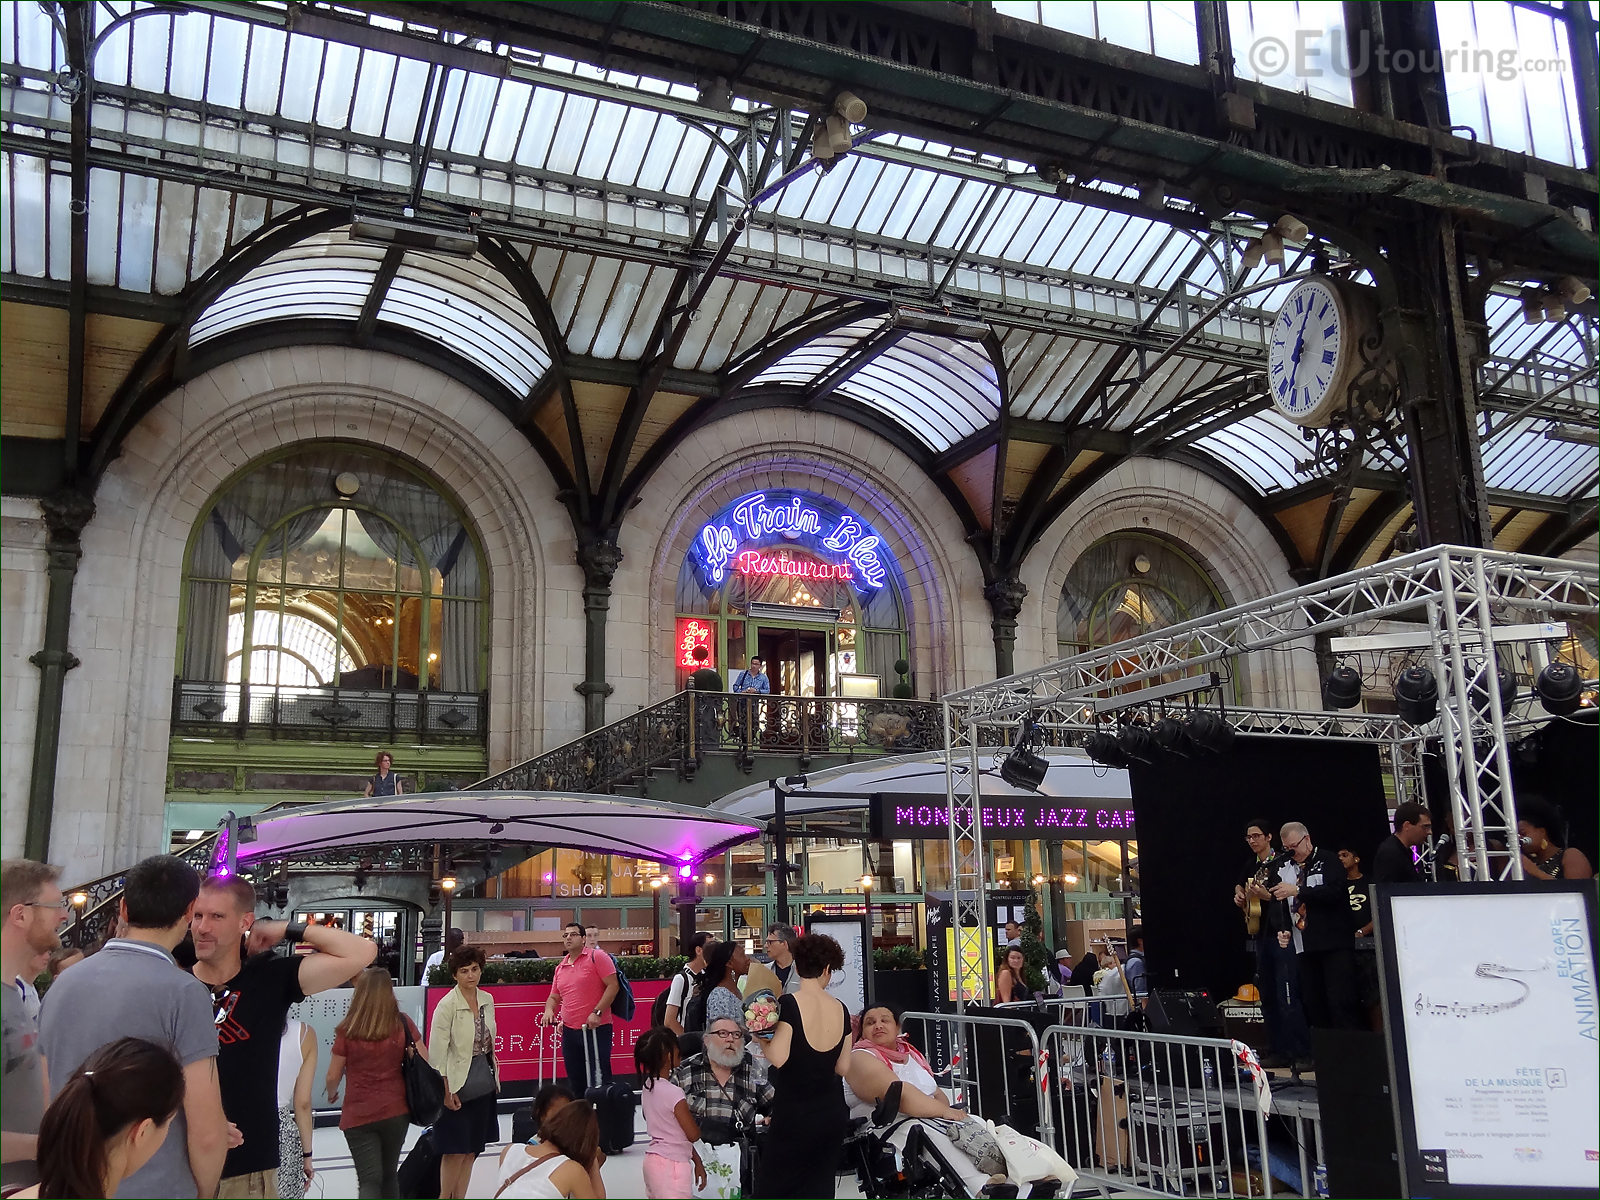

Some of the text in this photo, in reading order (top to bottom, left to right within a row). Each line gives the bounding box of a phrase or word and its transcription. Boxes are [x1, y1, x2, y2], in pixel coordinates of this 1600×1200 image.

[703, 494, 886, 588] Le Train Bleu
[738, 550, 852, 579] Restaurant
[685, 621, 709, 641] Big
[1034, 808, 1088, 828] JAZZ
[1096, 808, 1135, 829] CAF
[614, 865, 655, 878] JAZZ
[560, 884, 605, 897] SHOP
[1551, 919, 1568, 978] EN GARE
[932, 970, 940, 1001] JAZZ
[1562, 918, 1598, 1041] ANIMATION
[1516, 1067, 1541, 1076] FÊTE
[1465, 1078, 1543, 1088] DE LA MUSIQUE
[1469, 1131, 1485, 1139] Lyon
